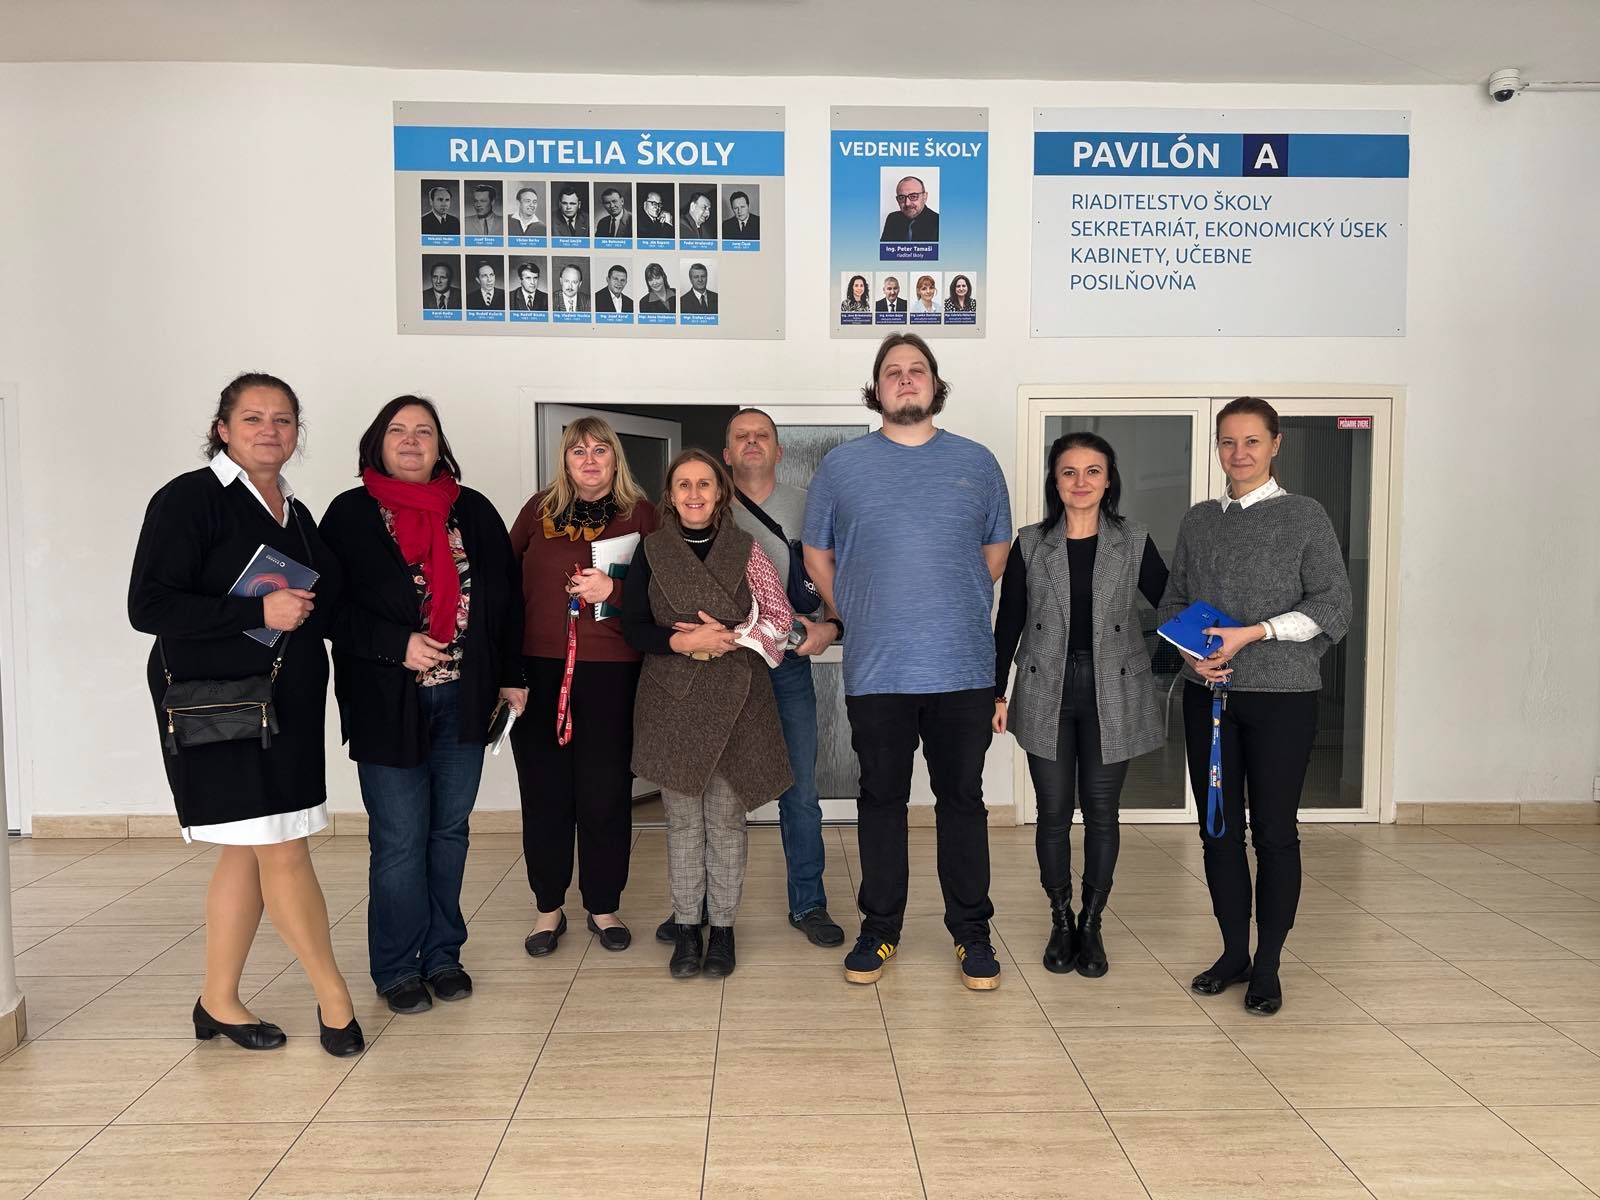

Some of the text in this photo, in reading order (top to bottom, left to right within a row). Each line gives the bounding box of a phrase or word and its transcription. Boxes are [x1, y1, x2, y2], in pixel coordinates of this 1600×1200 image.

[449, 133, 735, 166] RIADITELIA ŠKOLY
[840, 138, 981, 156] VEDENIE ŠKOLY
[1074, 134, 1278, 168] PAVILÓN A
[1072, 190, 1273, 211] RIADITEĽSTVO ŠKOLY
[1071, 217, 1387, 239] SEKRETARIÁT, EKONOMICKÝ ÚSEK
[1072, 244, 1252, 266] KABINETY, UČEBNE
[1071, 271, 1196, 290] POSILŇOVŇA
